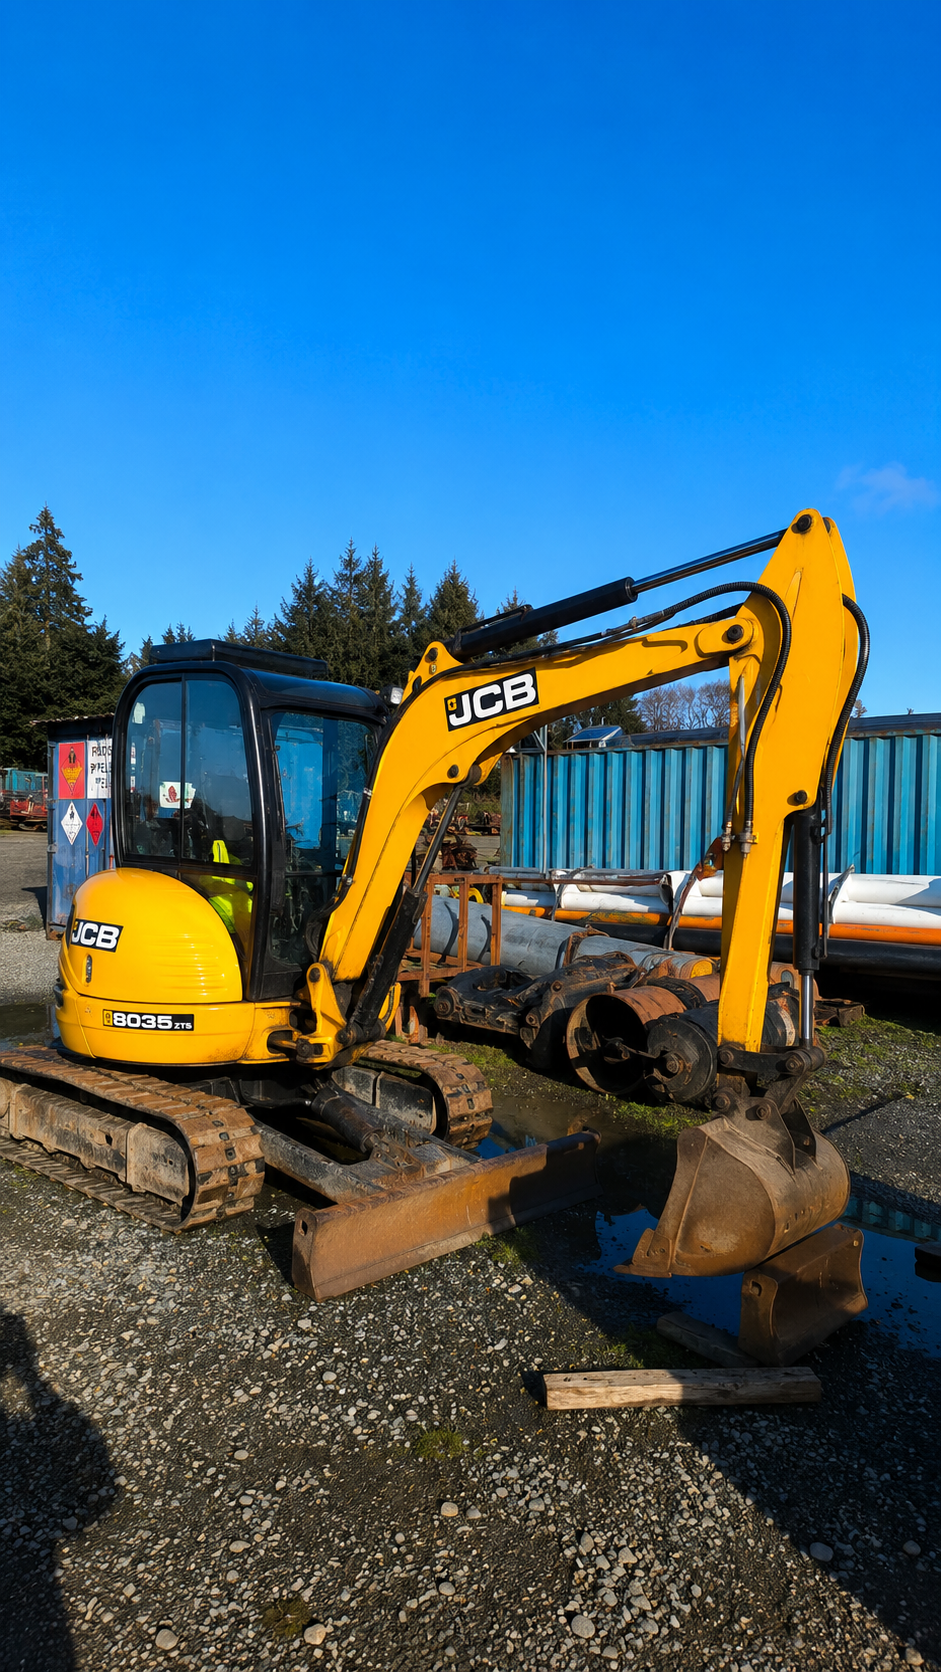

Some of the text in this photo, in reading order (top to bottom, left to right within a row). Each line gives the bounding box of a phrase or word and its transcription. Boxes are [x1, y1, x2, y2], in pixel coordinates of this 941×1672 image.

[449, 673, 536, 726] JCB
[71, 921, 120, 949] JCB
[113, 1012, 193, 1030] 8035 ZTS
